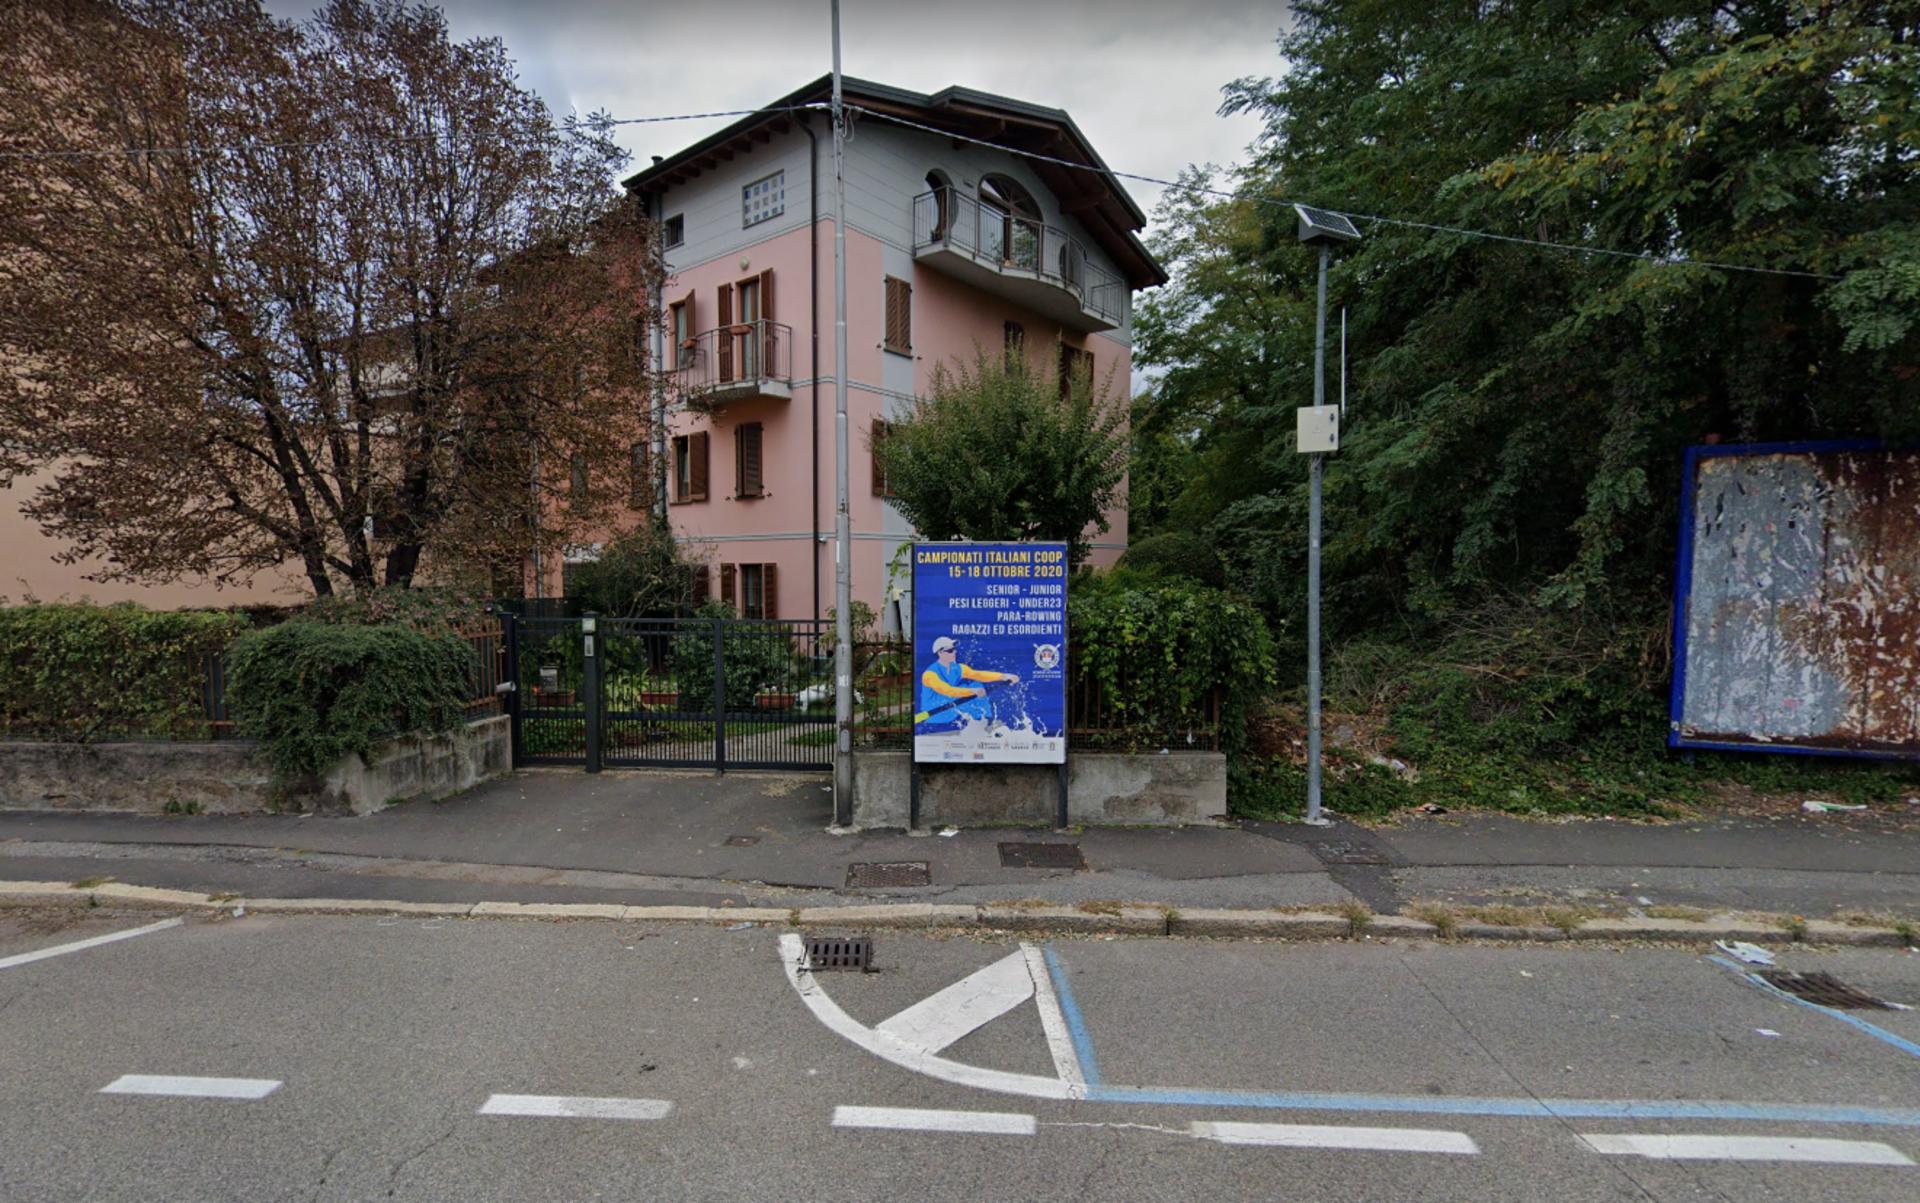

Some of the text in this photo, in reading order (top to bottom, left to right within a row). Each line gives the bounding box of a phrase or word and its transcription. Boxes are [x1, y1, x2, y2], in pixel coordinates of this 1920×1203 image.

[917, 551, 1063, 563] CAMPIONATI ITALIANI COOP
[983, 565, 1030, 577] OTTOBRE
[1034, 565, 1063, 577] 2020
[986, 584, 1020, 595] SENIOR
[1029, 584, 1062, 595] JUNIOR
[949, 598, 969, 609] PESI
[972, 598, 1009, 609] LEGGERI
[1019, 598, 1061, 609] UNDER23
[997, 611, 1061, 622] PARA-ROWING
[952, 624, 1062, 635] RAGAZZI ED ESORDIENTI
